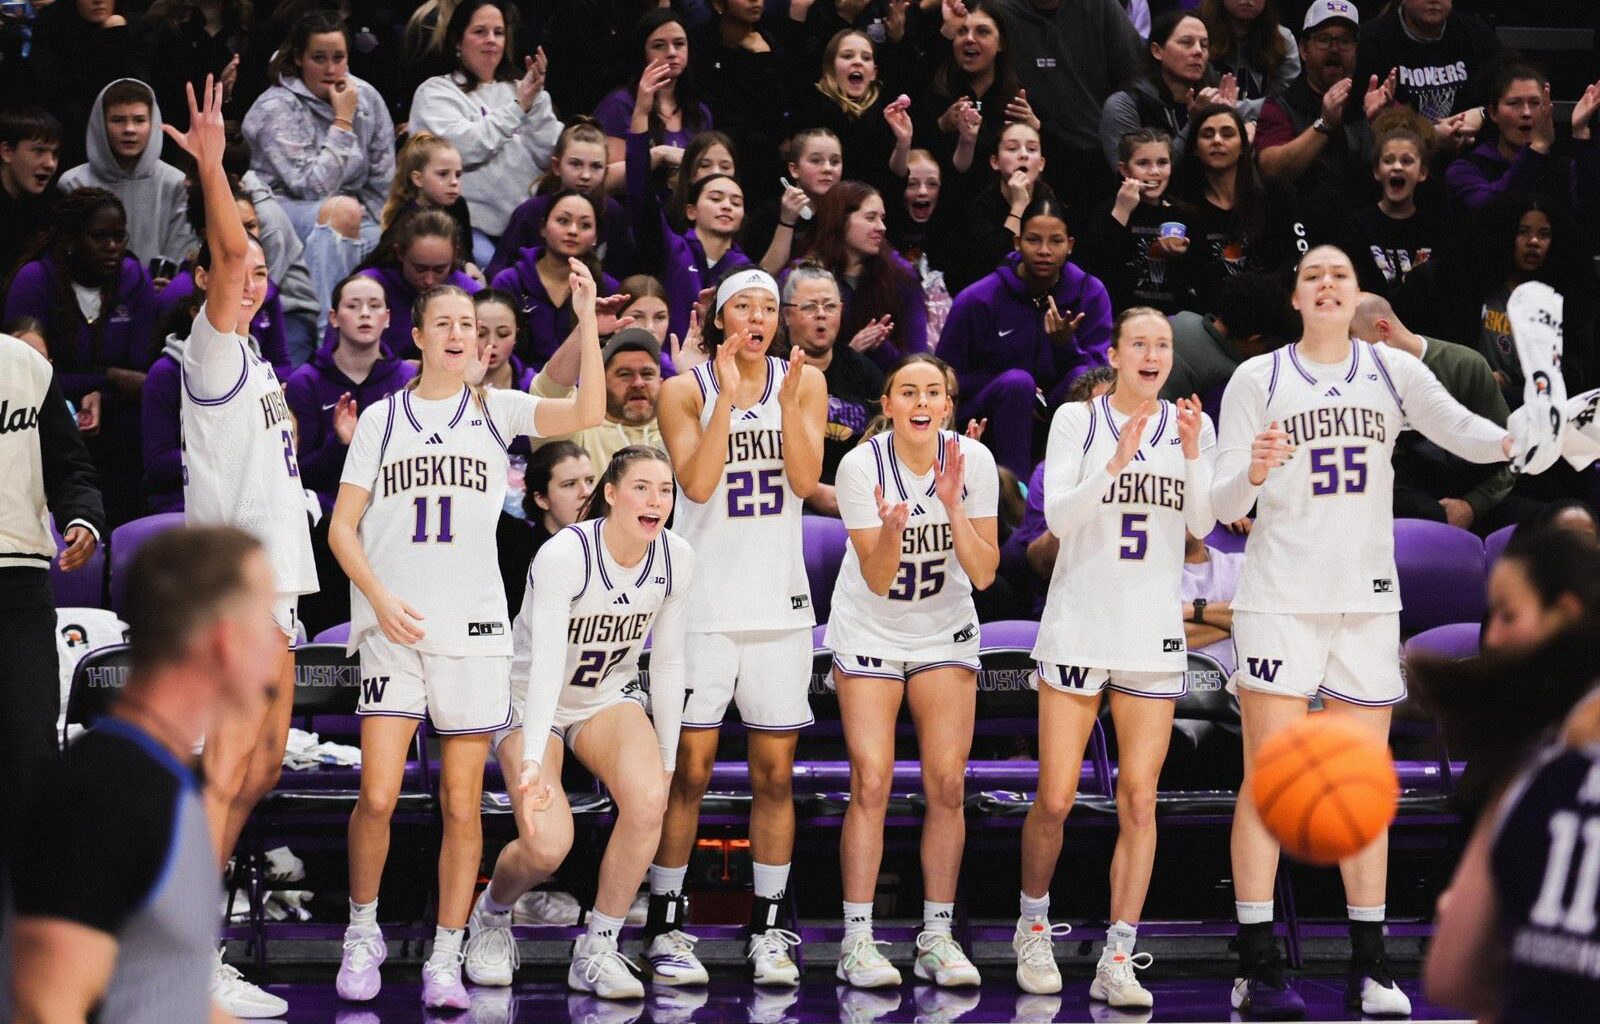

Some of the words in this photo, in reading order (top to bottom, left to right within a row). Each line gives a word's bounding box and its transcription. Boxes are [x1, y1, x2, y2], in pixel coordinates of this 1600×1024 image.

[1283, 407, 1385, 446] HUSKIES
[281, 430, 299, 477] 2
[1310, 445, 1369, 496] 55
[382, 455, 488, 498] HUSKIES
[726, 468, 784, 518] 25
[411, 495, 454, 544] 11
[1119, 512, 1149, 561] 5
[888, 557, 947, 602] 35
[567, 611, 653, 645] HUSKIE
[362, 676, 390, 705] W
[1055, 664, 1093, 689] W
[1247, 657, 1283, 684] W
